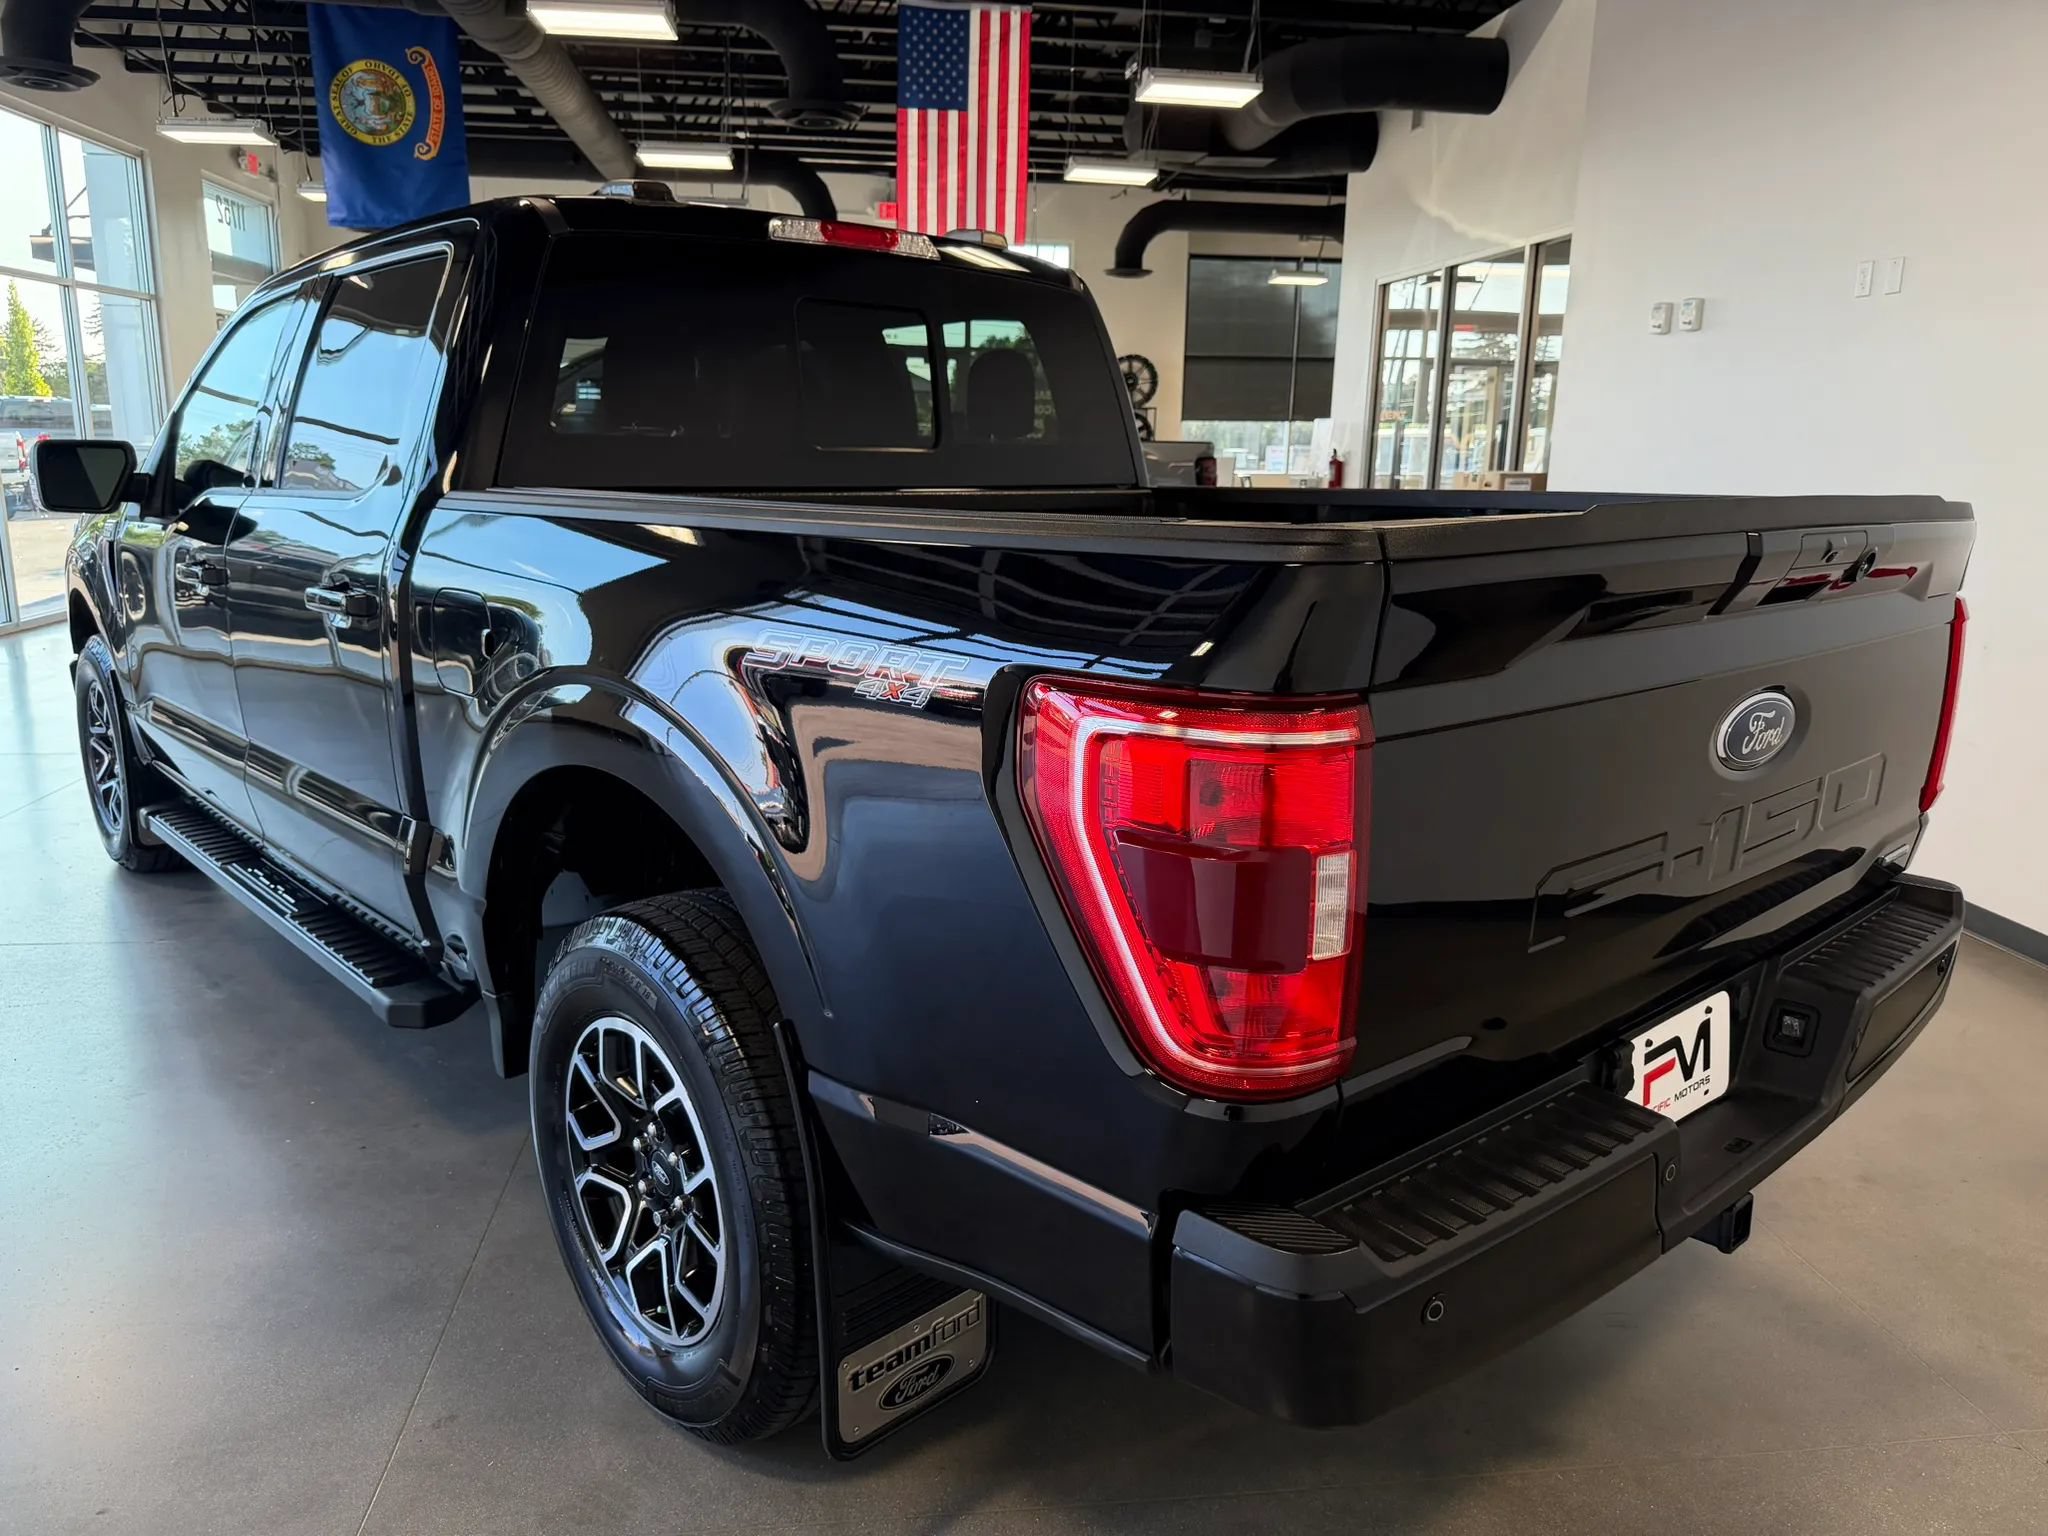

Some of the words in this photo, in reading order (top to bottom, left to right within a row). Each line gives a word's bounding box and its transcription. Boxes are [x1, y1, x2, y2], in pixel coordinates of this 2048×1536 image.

[742, 628, 970, 687] SPORT
[1741, 710, 1786, 755] Ford
[1674, 1075, 1711, 1102] MOTORS
[895, 1363, 941, 1404] Ford
